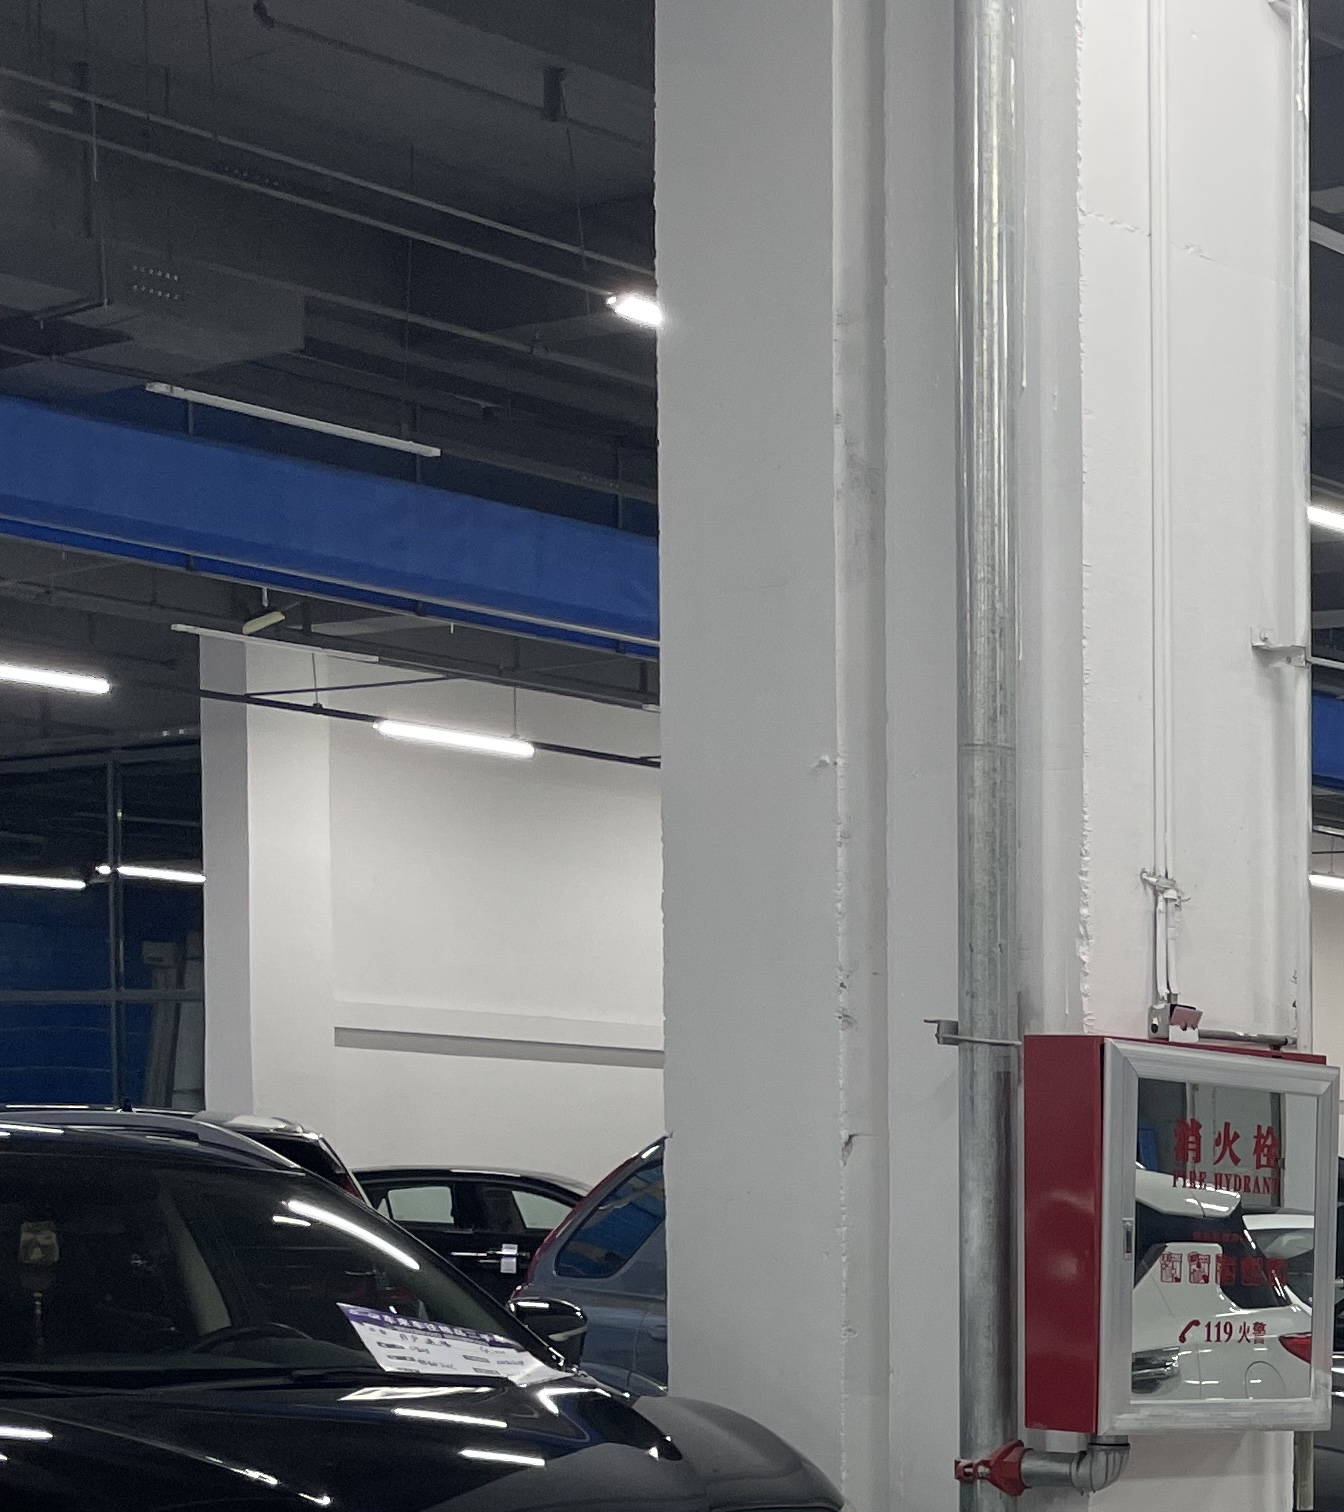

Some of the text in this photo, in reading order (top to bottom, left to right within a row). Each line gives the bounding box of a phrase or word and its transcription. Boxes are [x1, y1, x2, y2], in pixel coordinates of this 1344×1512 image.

[1173, 1118, 1281, 1170] 消火栓
[1172, 1170, 1280, 1195] FIRE HYDRANT
